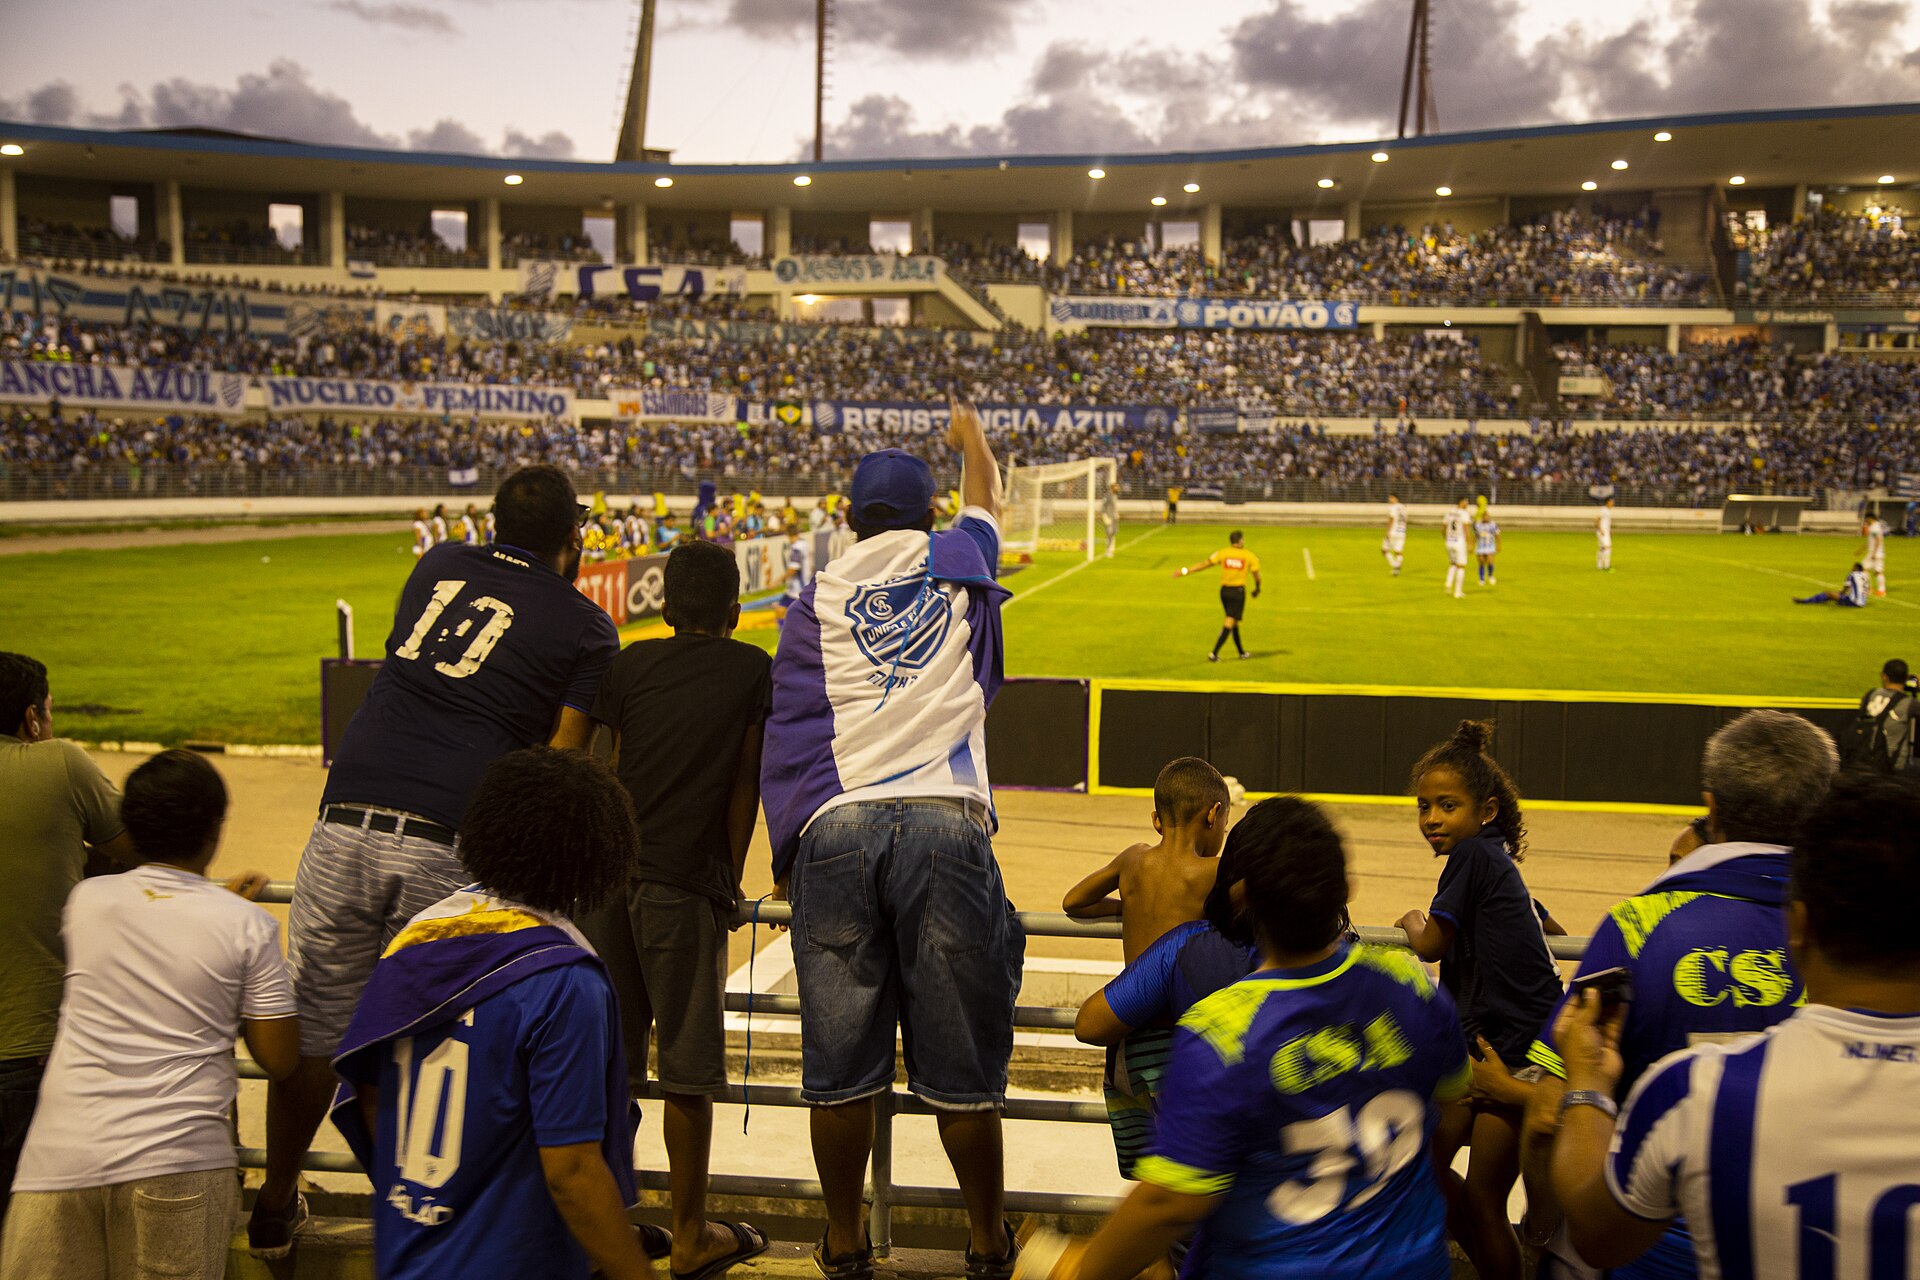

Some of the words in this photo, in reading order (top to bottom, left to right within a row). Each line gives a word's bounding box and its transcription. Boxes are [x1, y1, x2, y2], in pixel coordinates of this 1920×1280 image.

[130, 367, 217, 404] AZUL
[422, 386, 567, 415] FEMININO
[841, 406, 1041, 434] RESISTNCIA
[1672, 943, 1807, 1010] CS
[393, 1036, 469, 1189] 10
